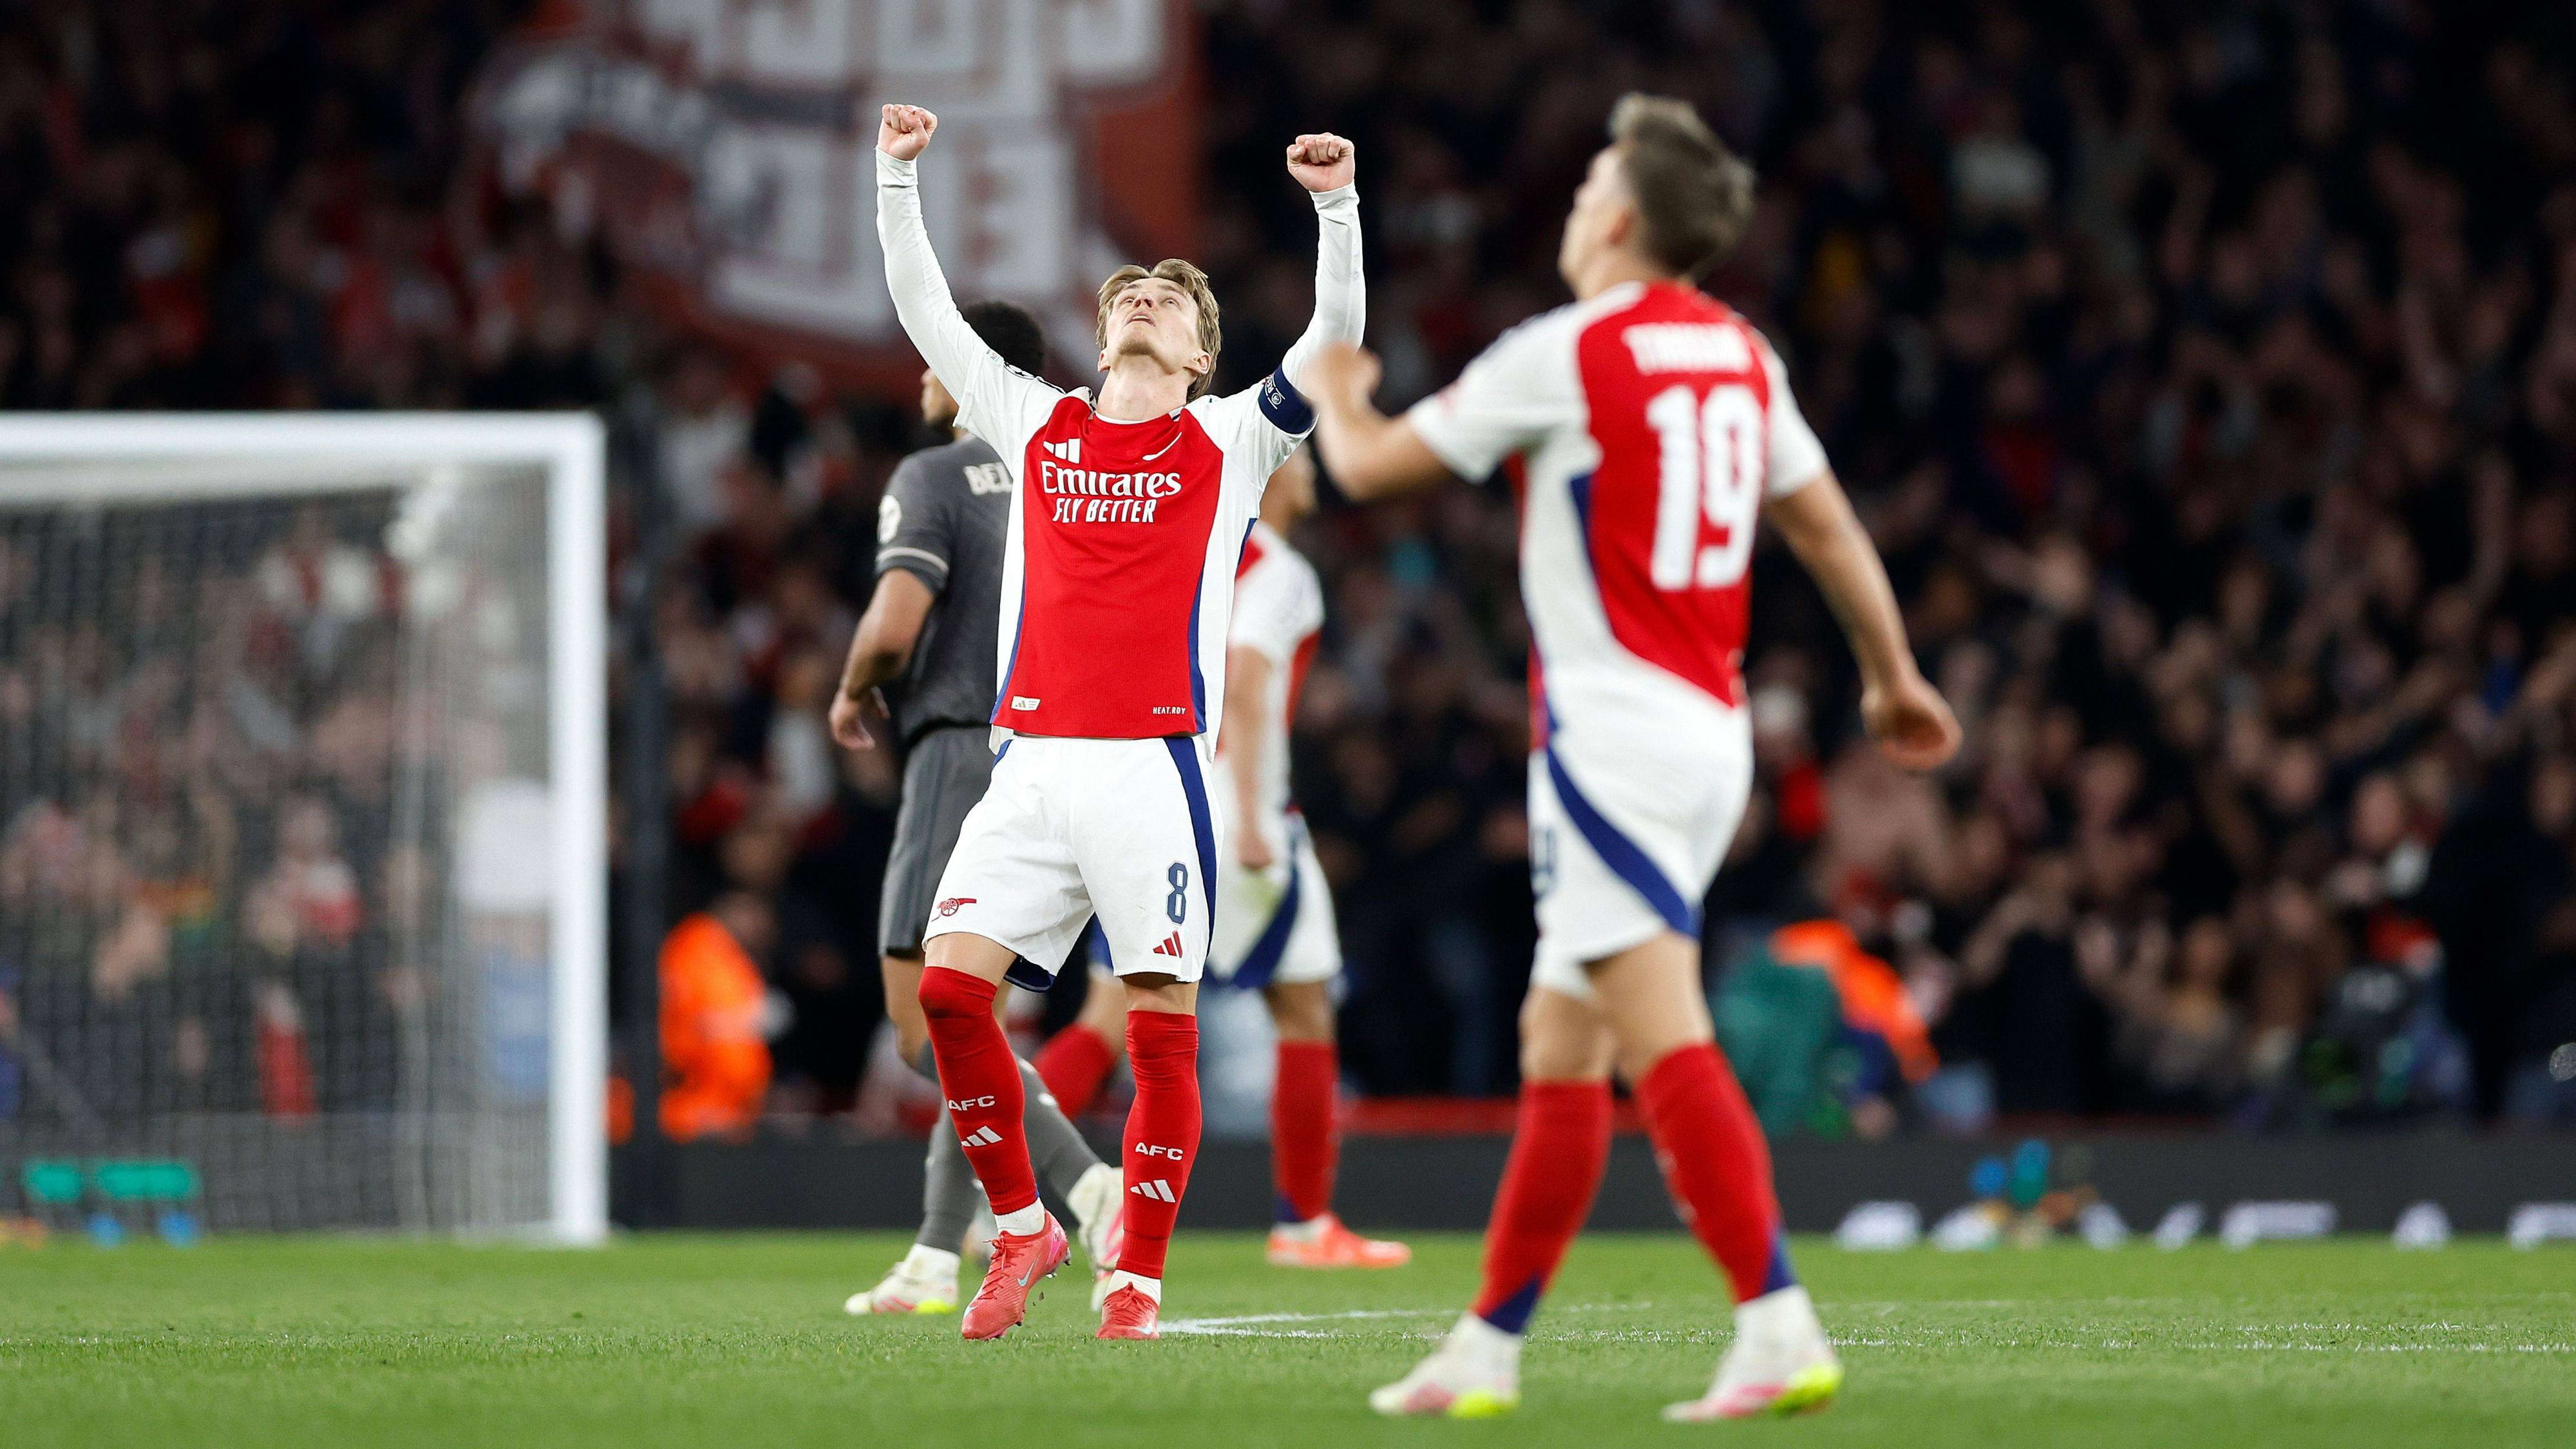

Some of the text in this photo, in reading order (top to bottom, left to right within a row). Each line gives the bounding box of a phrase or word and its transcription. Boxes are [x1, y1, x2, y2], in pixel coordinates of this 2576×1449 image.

[1041, 460, 1182, 498] Emirates
[1646, 384, 1765, 591] 19
[1052, 498, 1157, 523] FLY BETTER
[1153, 706, 1186, 715] HEAT.RDY
[1166, 860, 1188, 926] 8
[948, 1095, 995, 1111] AFC
[1135, 1142, 1183, 1160] AFC
